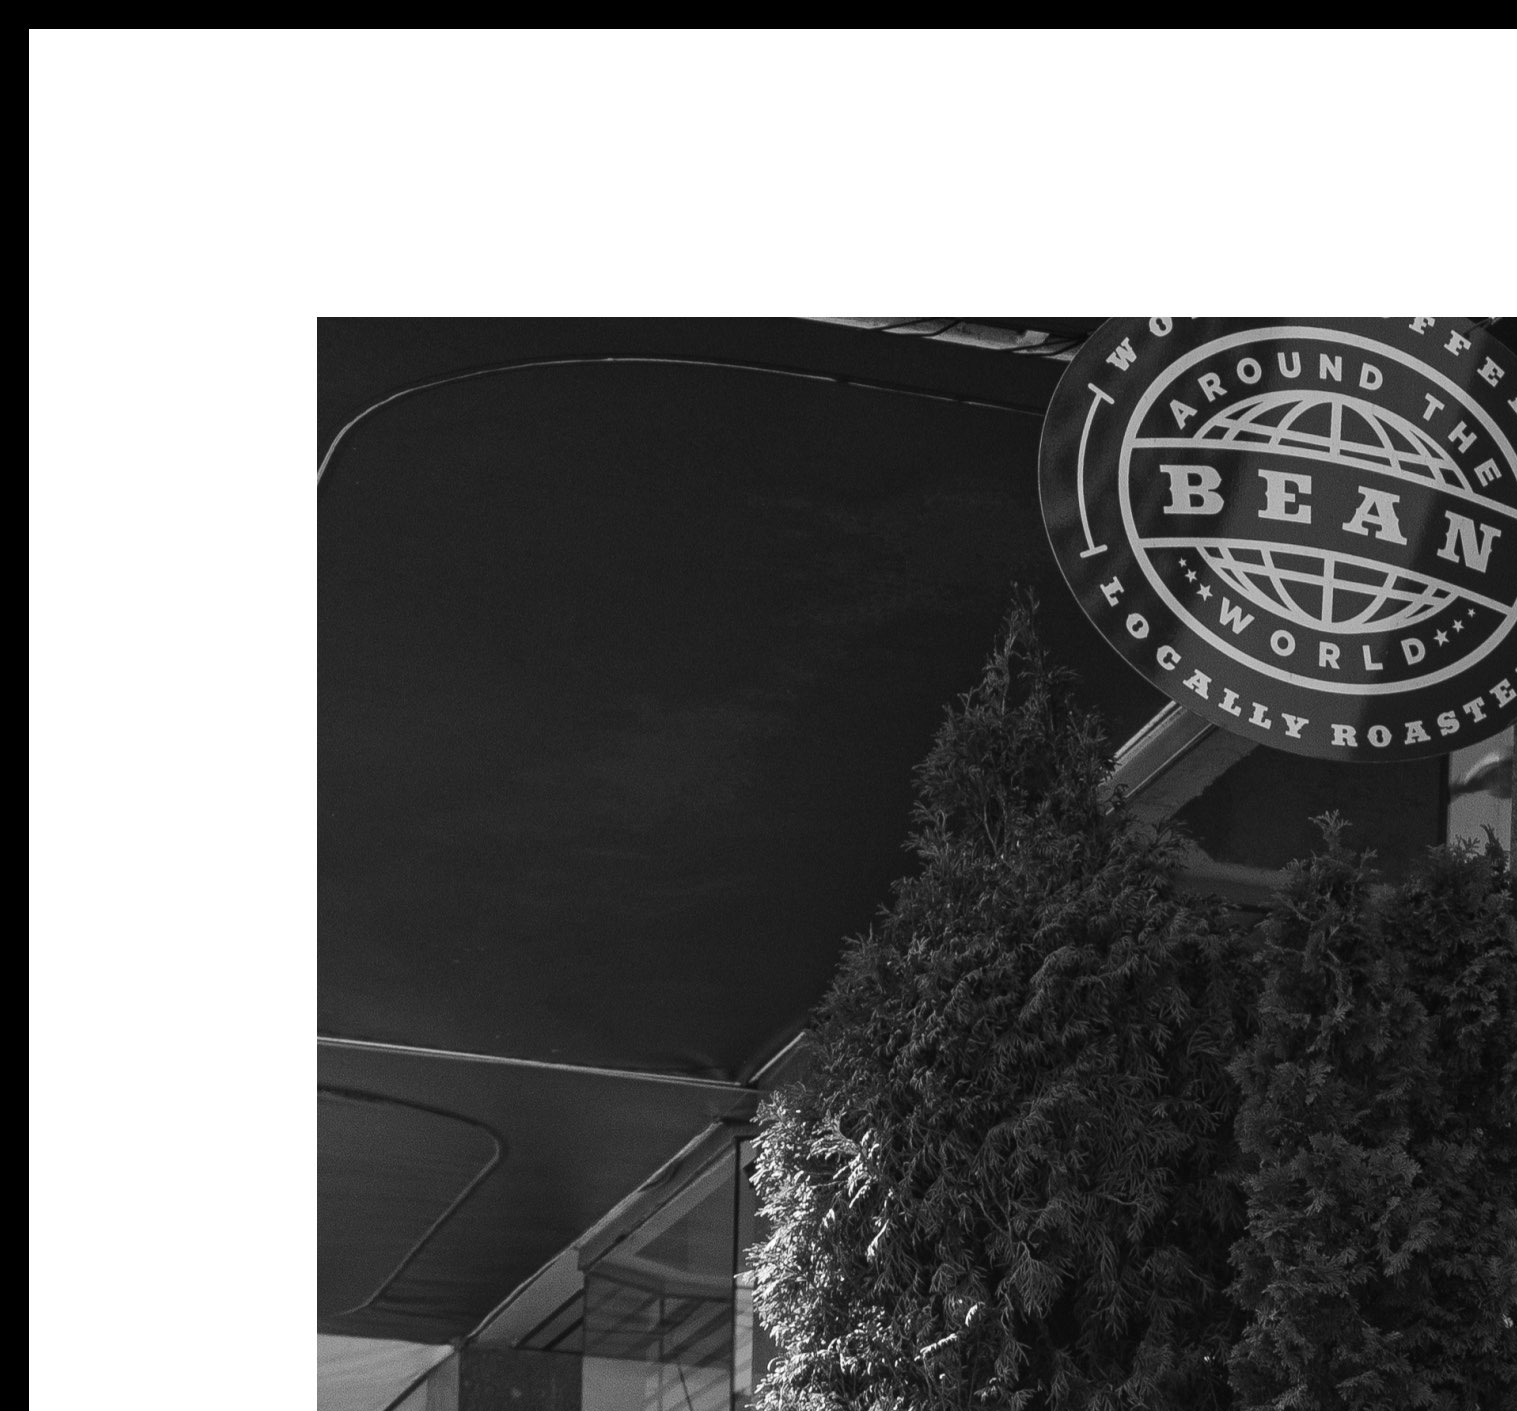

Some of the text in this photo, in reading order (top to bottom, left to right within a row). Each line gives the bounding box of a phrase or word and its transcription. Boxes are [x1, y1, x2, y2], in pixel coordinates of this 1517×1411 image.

[1168, 351, 1502, 487] AROUND THE
[1159, 464, 1502, 573] BEAN
[1100, 576, 1309, 739] LOCALLY
[1218, 598, 1426, 671] WORLD
